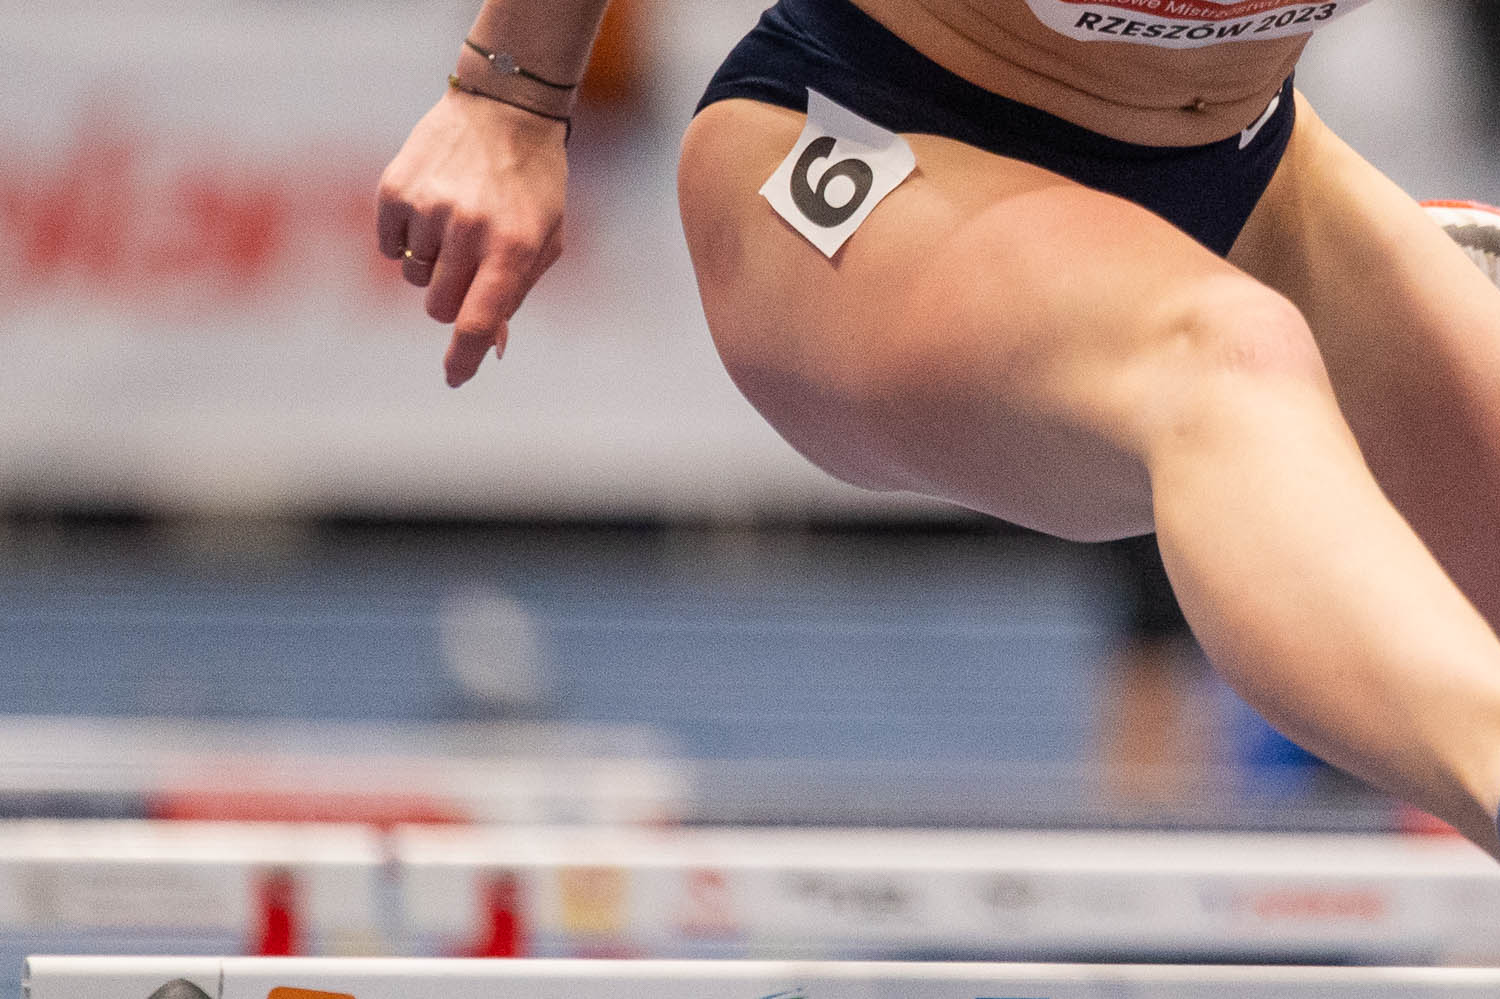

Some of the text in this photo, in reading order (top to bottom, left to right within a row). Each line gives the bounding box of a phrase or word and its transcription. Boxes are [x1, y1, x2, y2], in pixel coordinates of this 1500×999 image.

[1074, 3, 1337, 40] RZESZÓW 2023
[790, 136, 874, 228] 6
